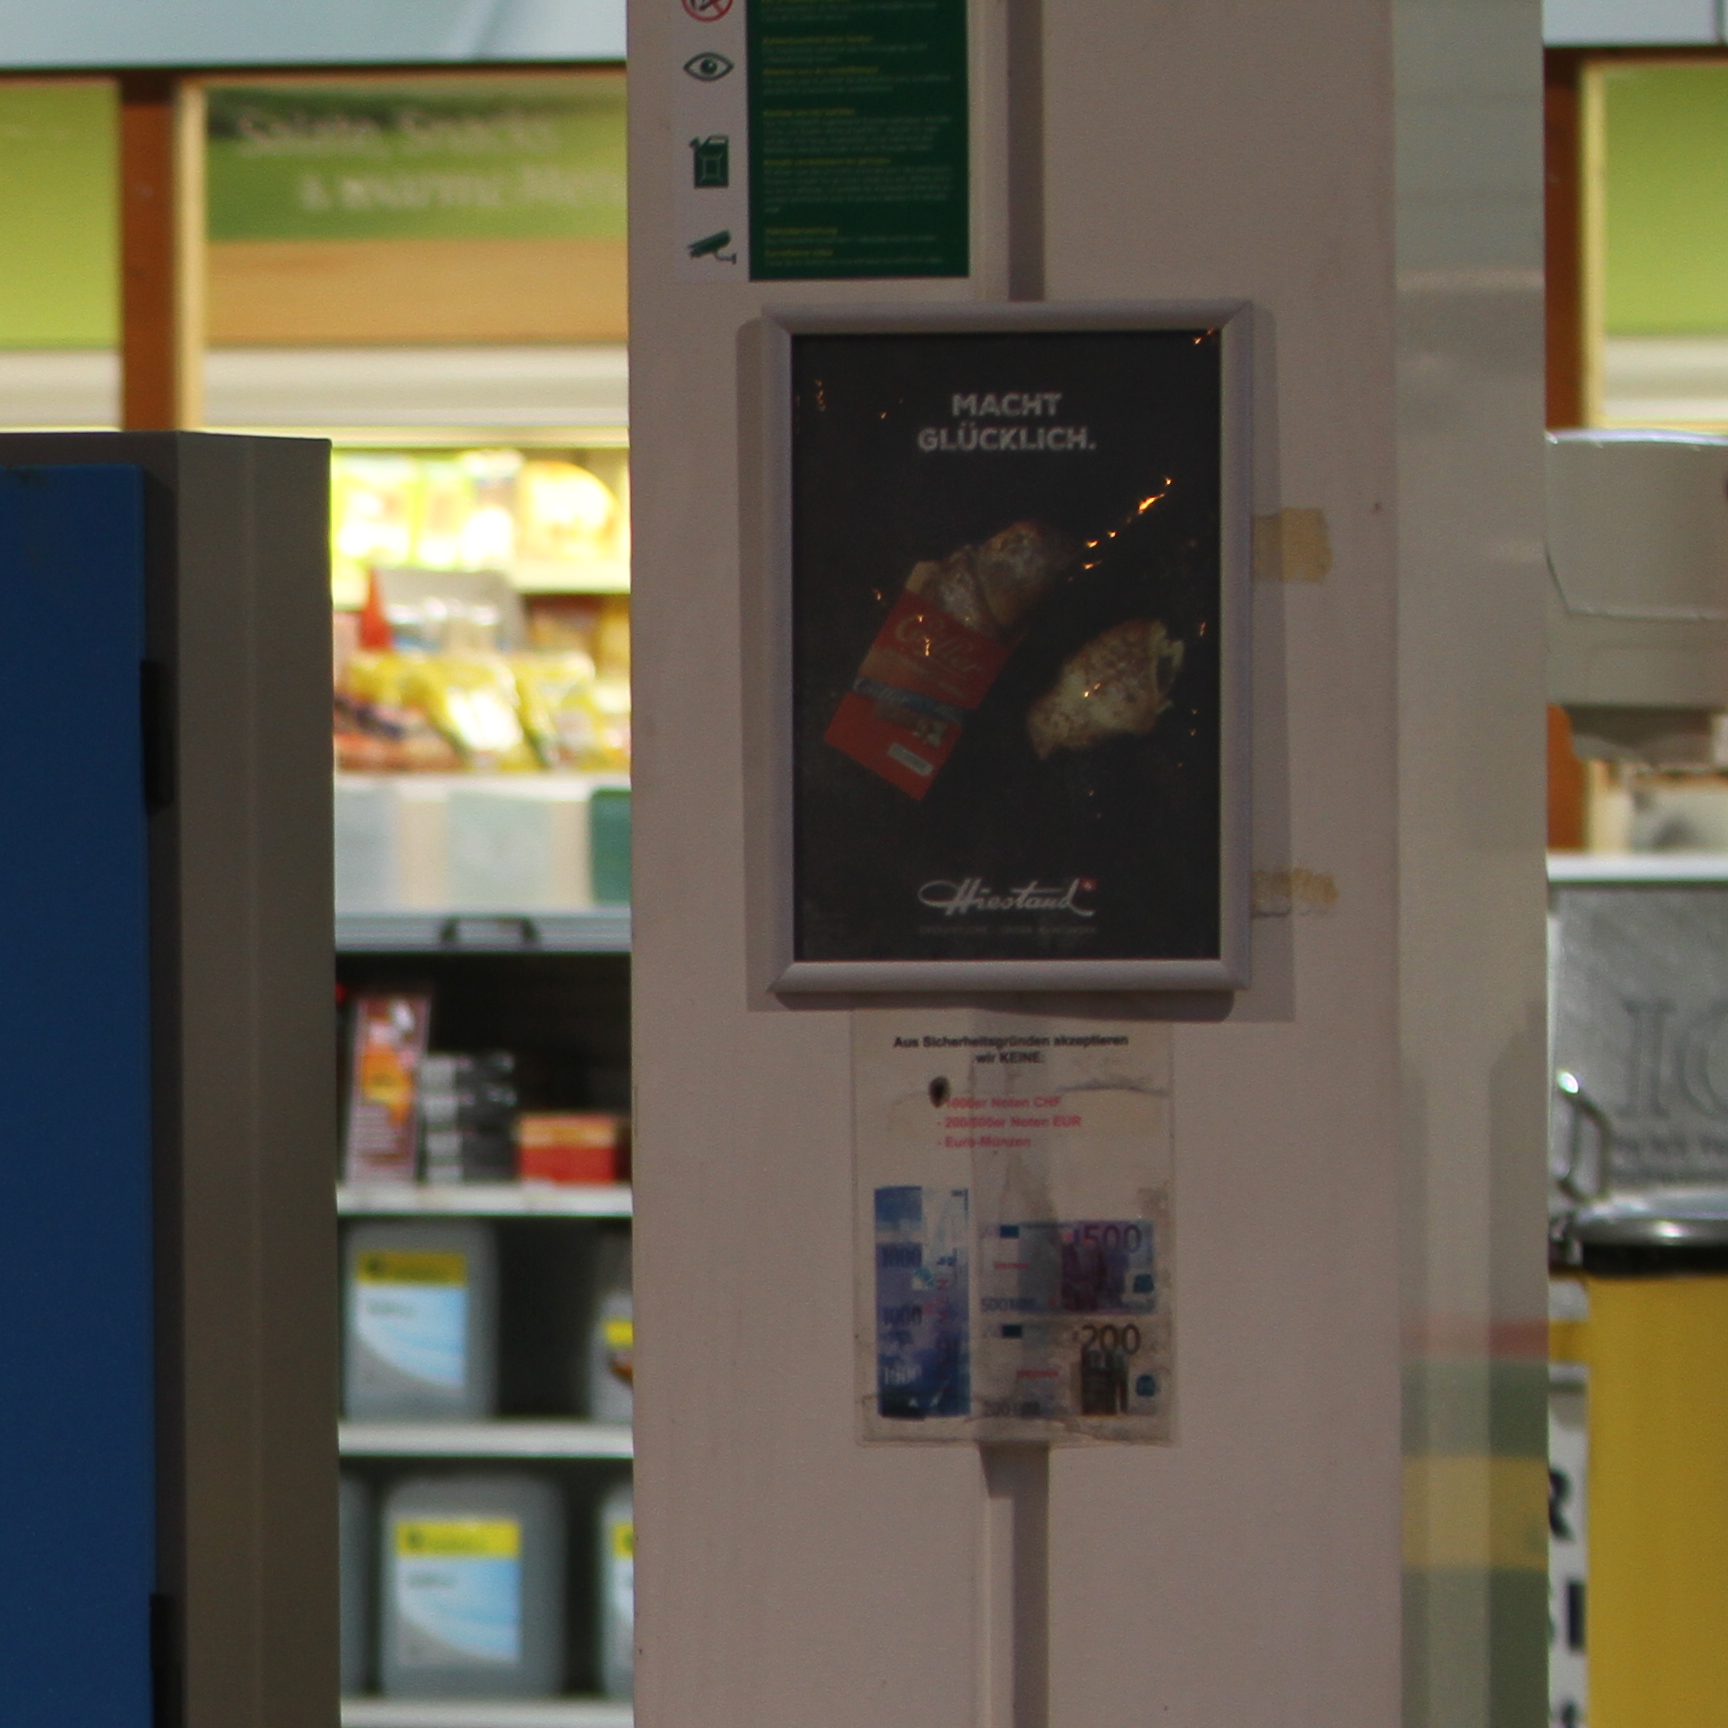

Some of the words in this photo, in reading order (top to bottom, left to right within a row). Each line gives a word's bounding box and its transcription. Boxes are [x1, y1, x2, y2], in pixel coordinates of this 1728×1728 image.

[951, 392, 1062, 416] MACHT
[917, 421, 1096, 451] GLÜCKLICH.
[917, 877, 1096, 917] Hiestand
[894, 1037, 919, 1048] Aus
[923, 1035, 1050, 1051] Sicherheitsgründen
[1053, 1034, 1129, 1049] akzeptieren
[1052, 1115, 1082, 1128] EUR
[1083, 1224, 1142, 1253] 500
[1081, 1323, 1142, 1356] 200
